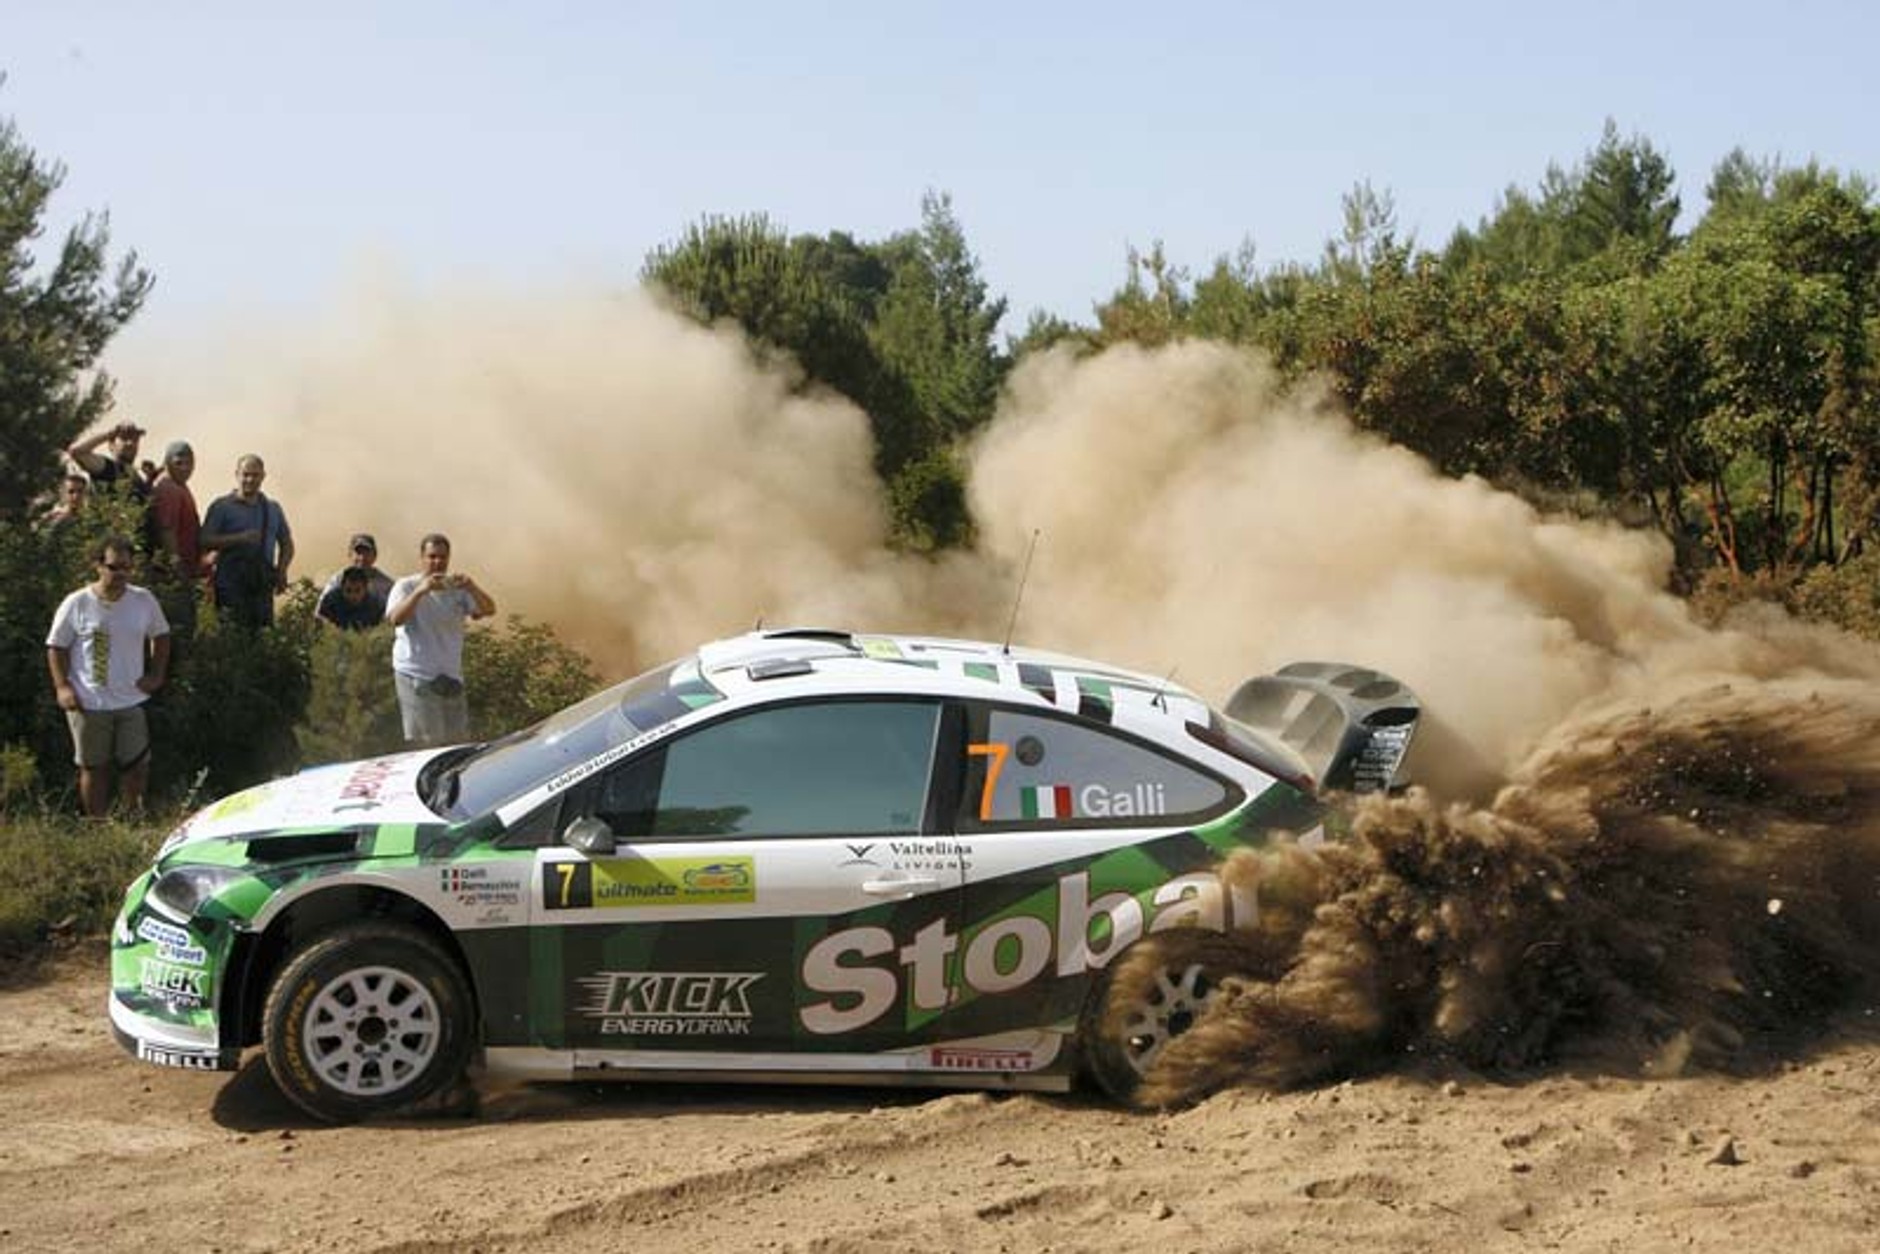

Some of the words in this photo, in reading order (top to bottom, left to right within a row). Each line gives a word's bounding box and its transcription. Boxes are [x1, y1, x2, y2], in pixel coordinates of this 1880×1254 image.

[968, 744, 1009, 821] 7
[1080, 783, 1165, 817] Galli
[889, 842, 973, 855] Valtellina
[556, 864, 575, 906] 7
[600, 972, 766, 1016] KICK
